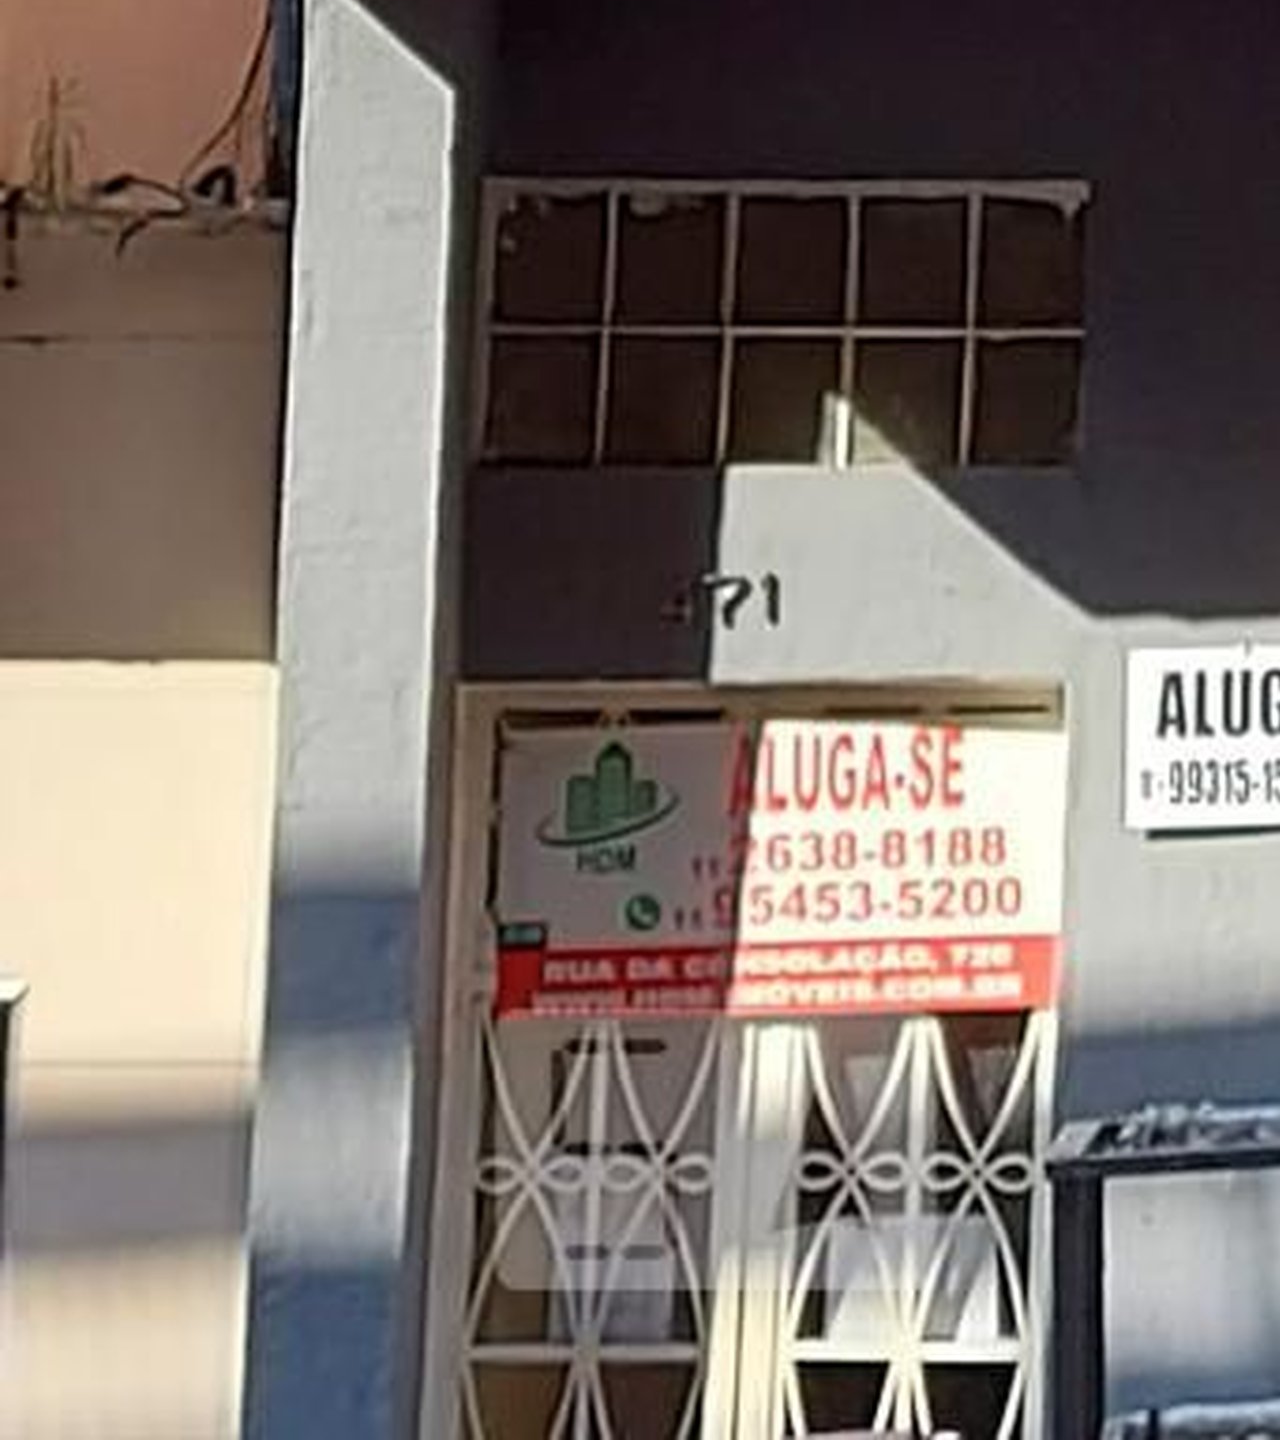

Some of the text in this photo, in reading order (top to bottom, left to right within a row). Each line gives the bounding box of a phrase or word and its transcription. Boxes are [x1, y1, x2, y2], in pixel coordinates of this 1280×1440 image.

[726, 724, 966, 815] ALUGA-SE
[712, 877, 1024, 928] 95453-5200
[544, 957, 616, 985] RUA
